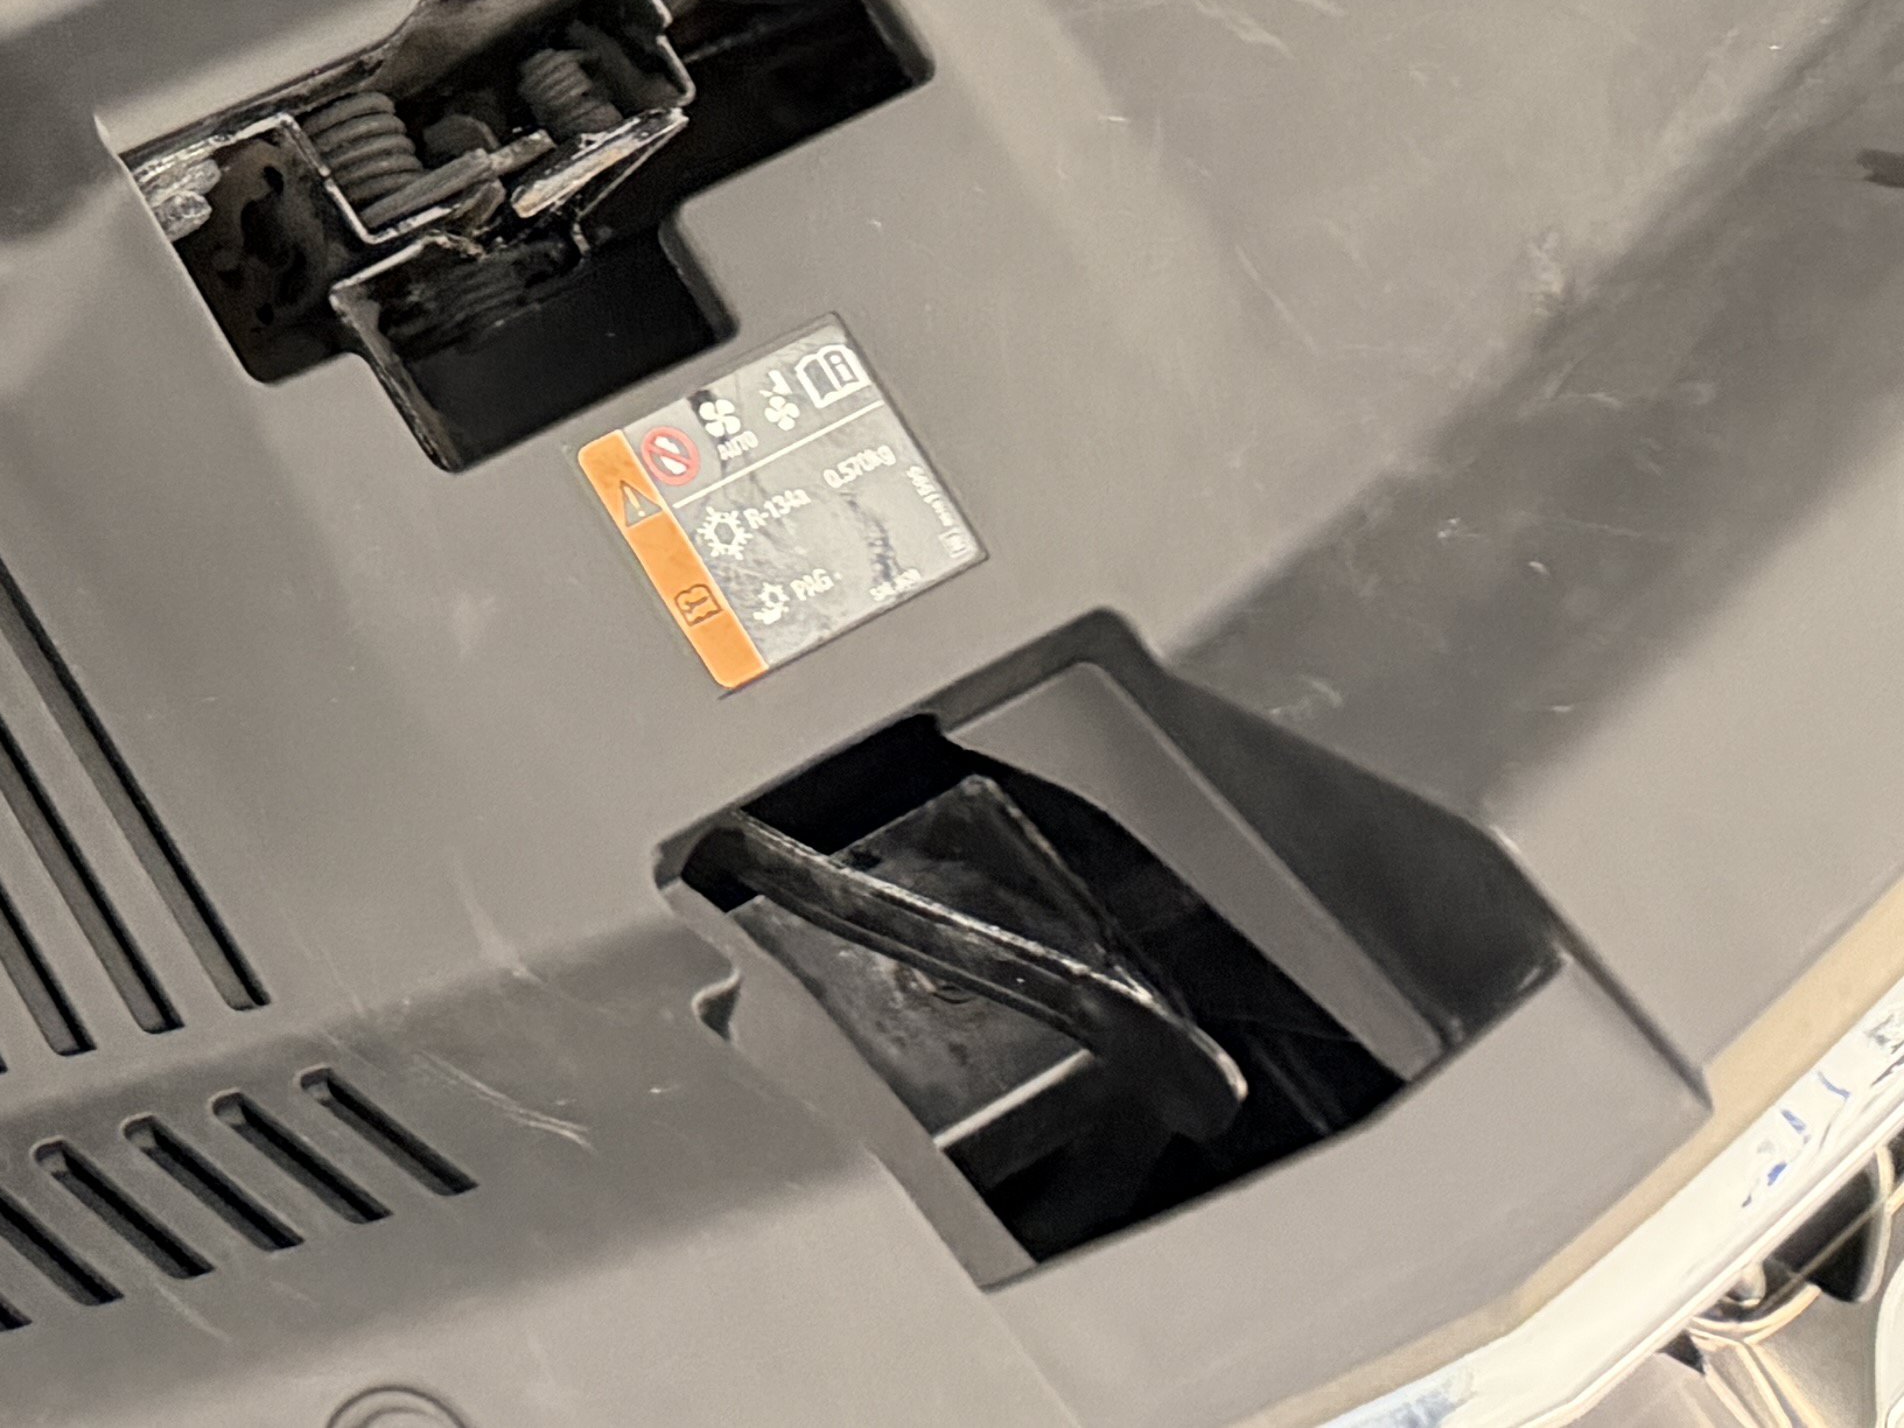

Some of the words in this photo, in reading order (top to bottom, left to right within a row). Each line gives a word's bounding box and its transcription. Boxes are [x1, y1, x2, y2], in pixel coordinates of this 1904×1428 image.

[719, 431, 759, 459] AUTO
[743, 489, 812, 530] R-134a
[792, 569, 833, 601] PAG
